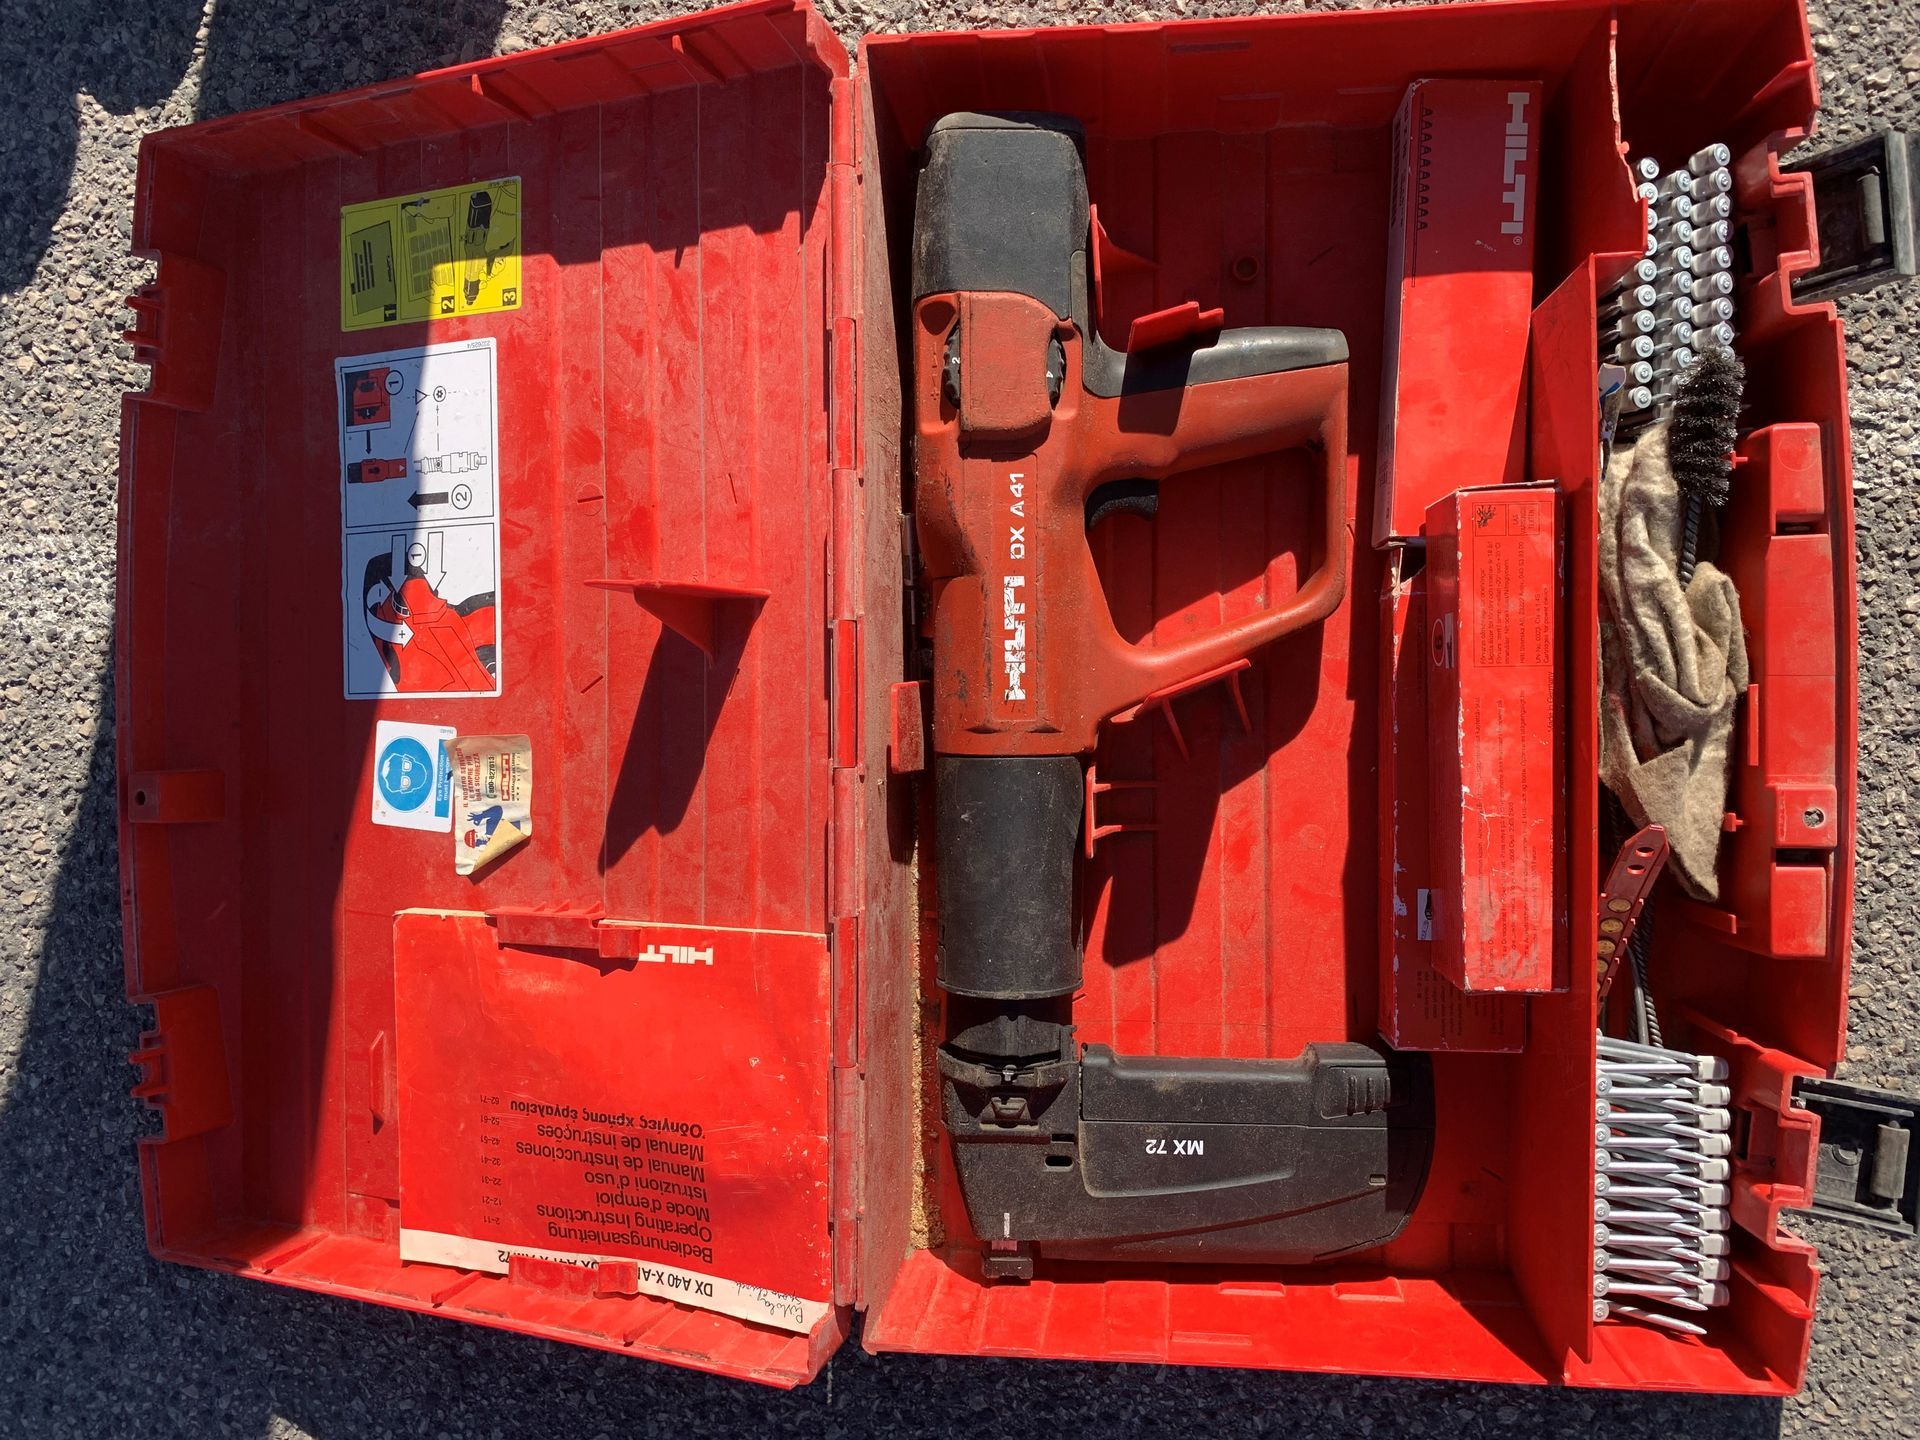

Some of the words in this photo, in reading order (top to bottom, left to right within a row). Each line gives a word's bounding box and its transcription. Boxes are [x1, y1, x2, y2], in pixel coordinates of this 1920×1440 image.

[443, 299, 454, 309] 2
[504, 292, 516, 301] 3
[1010, 526, 1025, 559] DX
[1004, 576, 1025, 700] HILTI
[638, 945, 713, 966] HILT
[537, 1124, 616, 1149] instruções
[621, 1136, 641, 1152] de
[1146, 1140, 1167, 1154] 72
[516, 1141, 619, 1169] Instrucciones
[646, 1138, 704, 1162] Manual
[1173, 1140, 1204, 1155] MX
[623, 1156, 643, 1171] de
[648, 1159, 705, 1182] Manual
[584, 1172, 630, 1188] d'uso
[635, 1177, 708, 1202] Istruzioni
[596, 1192, 661, 1214] d'emploi
[666, 1202, 710, 1222] Mode
[537, 1204, 630, 1229] Instructions
[635, 1212, 712, 1242] Operating
[548, 1222, 713, 1264] Bedienungsanleitung
[668, 1274, 692, 1292] A40
[694, 1279, 713, 1297] DX
